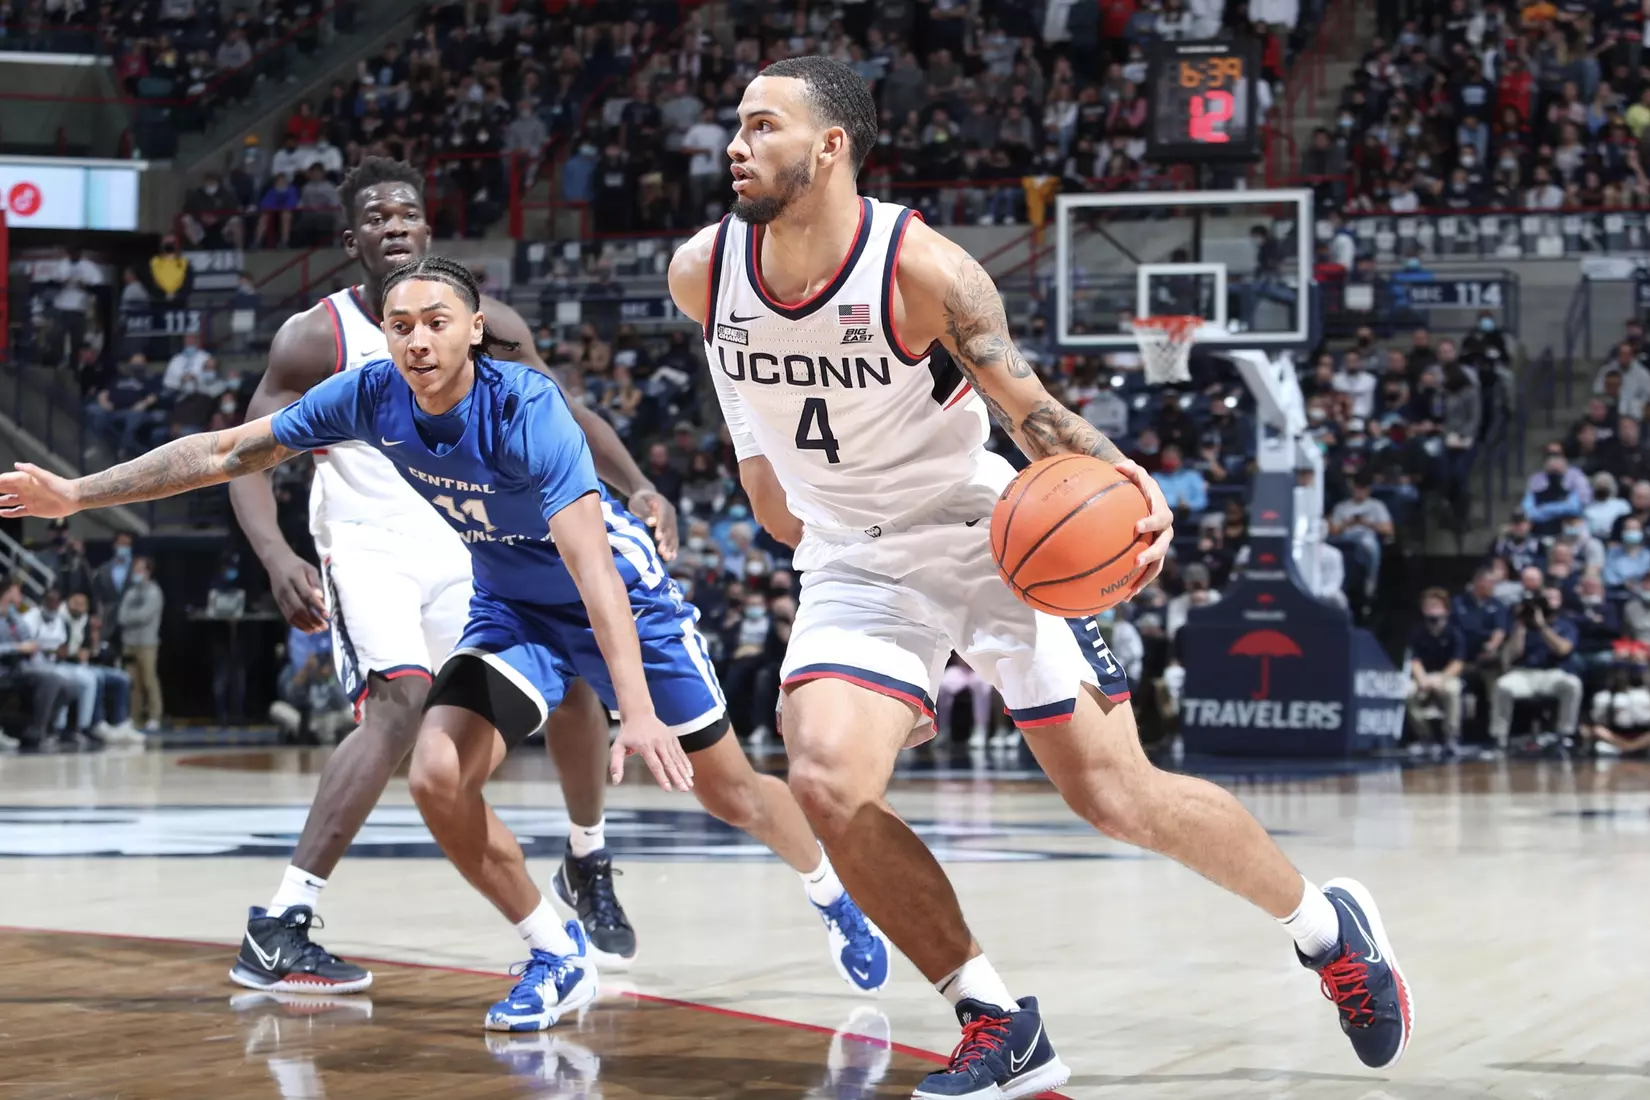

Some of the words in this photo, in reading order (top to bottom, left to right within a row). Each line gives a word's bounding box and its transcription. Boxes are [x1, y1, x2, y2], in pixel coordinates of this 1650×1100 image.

[1188, 90, 1234, 143] 12
[1455, 282, 1502, 306] 114
[718, 346, 892, 389] UCONN
[795, 397, 841, 464] 4
[408, 466, 496, 494] CENTRAL
[432, 494, 499, 533] 11
[1181, 698, 1344, 730] TRAVELERS
